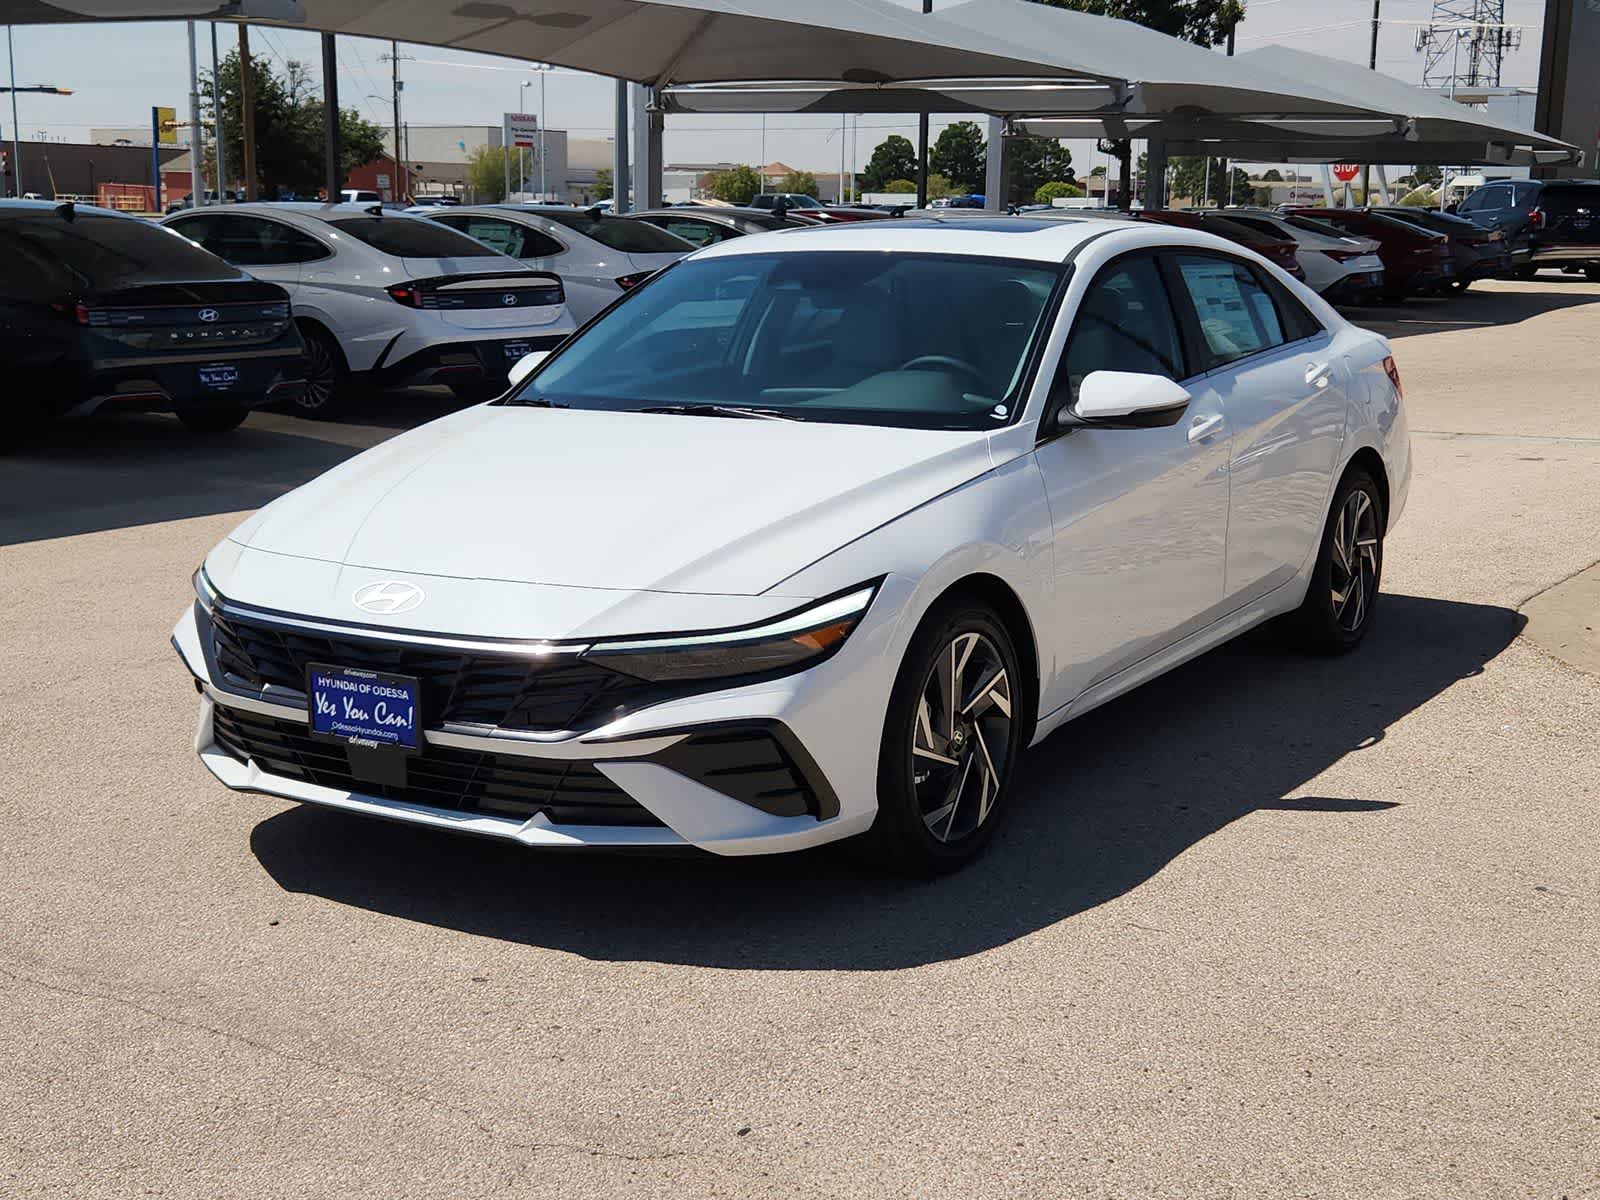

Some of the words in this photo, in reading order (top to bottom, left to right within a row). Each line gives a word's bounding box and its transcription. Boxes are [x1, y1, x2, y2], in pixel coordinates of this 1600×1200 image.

[1334, 164, 1357, 172] STOP
[170, 329, 251, 339] SONATA
[318, 677, 358, 692] HYUNDAI
[359, 683, 371, 694] OF
[372, 685, 409, 700] ODESSA
[315, 691, 337, 717] Yes
[343, 696, 369, 720] You
[374, 701, 414, 730] Can!
[348, 735, 378, 750] driveway
